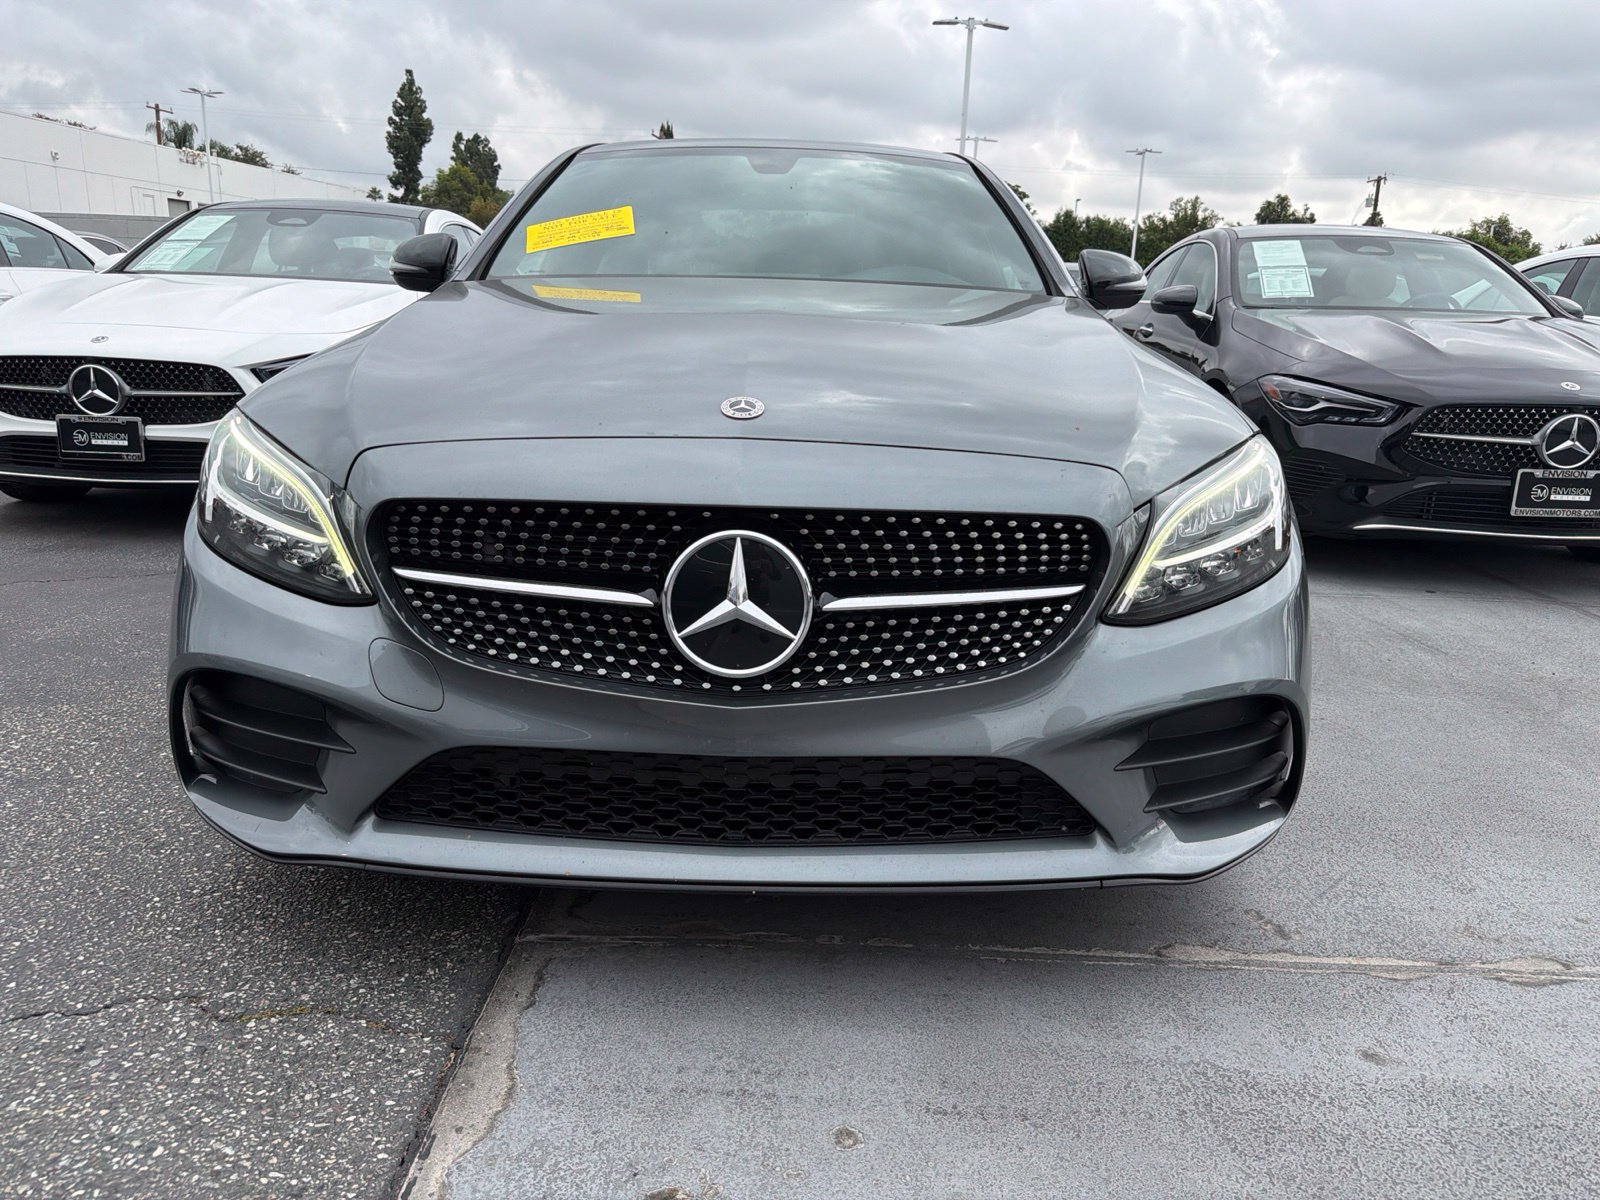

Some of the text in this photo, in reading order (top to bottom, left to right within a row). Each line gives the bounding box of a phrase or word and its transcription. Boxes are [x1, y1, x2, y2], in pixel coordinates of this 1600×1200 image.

[543, 223, 563, 231] NOT
[568, 218, 588, 226] FOR
[592, 213, 616, 221] SALE
[90, 432, 128, 440] ENVISION
[1551, 486, 1592, 495] ENVISION
[1514, 509, 1600, 517] ENVISIONMOTORS.COM
